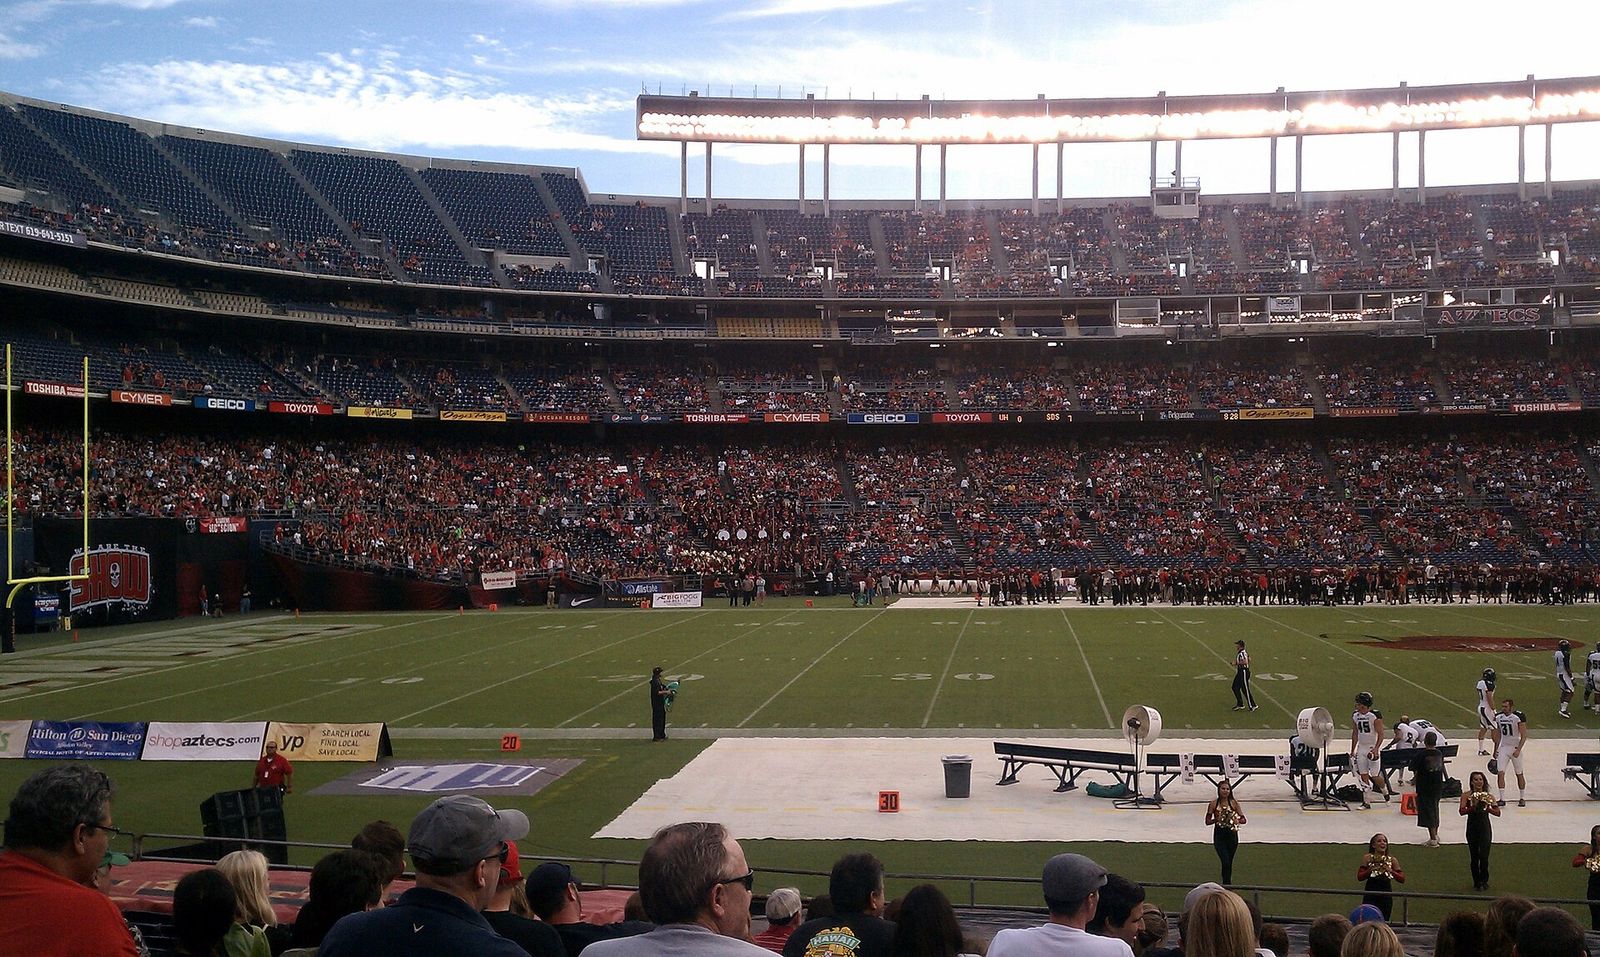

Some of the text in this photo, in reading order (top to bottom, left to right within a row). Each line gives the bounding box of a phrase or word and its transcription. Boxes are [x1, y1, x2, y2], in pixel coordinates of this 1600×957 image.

[5, 222, 24, 234] TEXT
[1437, 307, 1541, 325] AZTECS
[26, 382, 66, 396] TOSHIBA
[120, 392, 163, 405] CYMER
[207, 398, 246, 410] GEICO
[284, 403, 319, 414] TOYOTA
[1513, 403, 1556, 412] TOSHIBA
[686, 414, 726, 422] TOSHIBA
[773, 413, 821, 422] CYMER
[863, 414, 906, 423] GEICO
[124, 544, 146, 552] THE
[70, 551, 149, 611] SHOW
[635, 584, 658, 594] Allstate
[322, 729, 350, 737] SEARCH
[1358, 721, 1371, 733] 45
[1500, 723, 1513, 736] 31
[32, 728, 142, 744] Hilton San Diego
[148, 734, 260, 751] shopaztecs.com
[280, 735, 304, 751] yp
[502, 737, 516, 750] 20
[880, 793, 898, 810] 30
